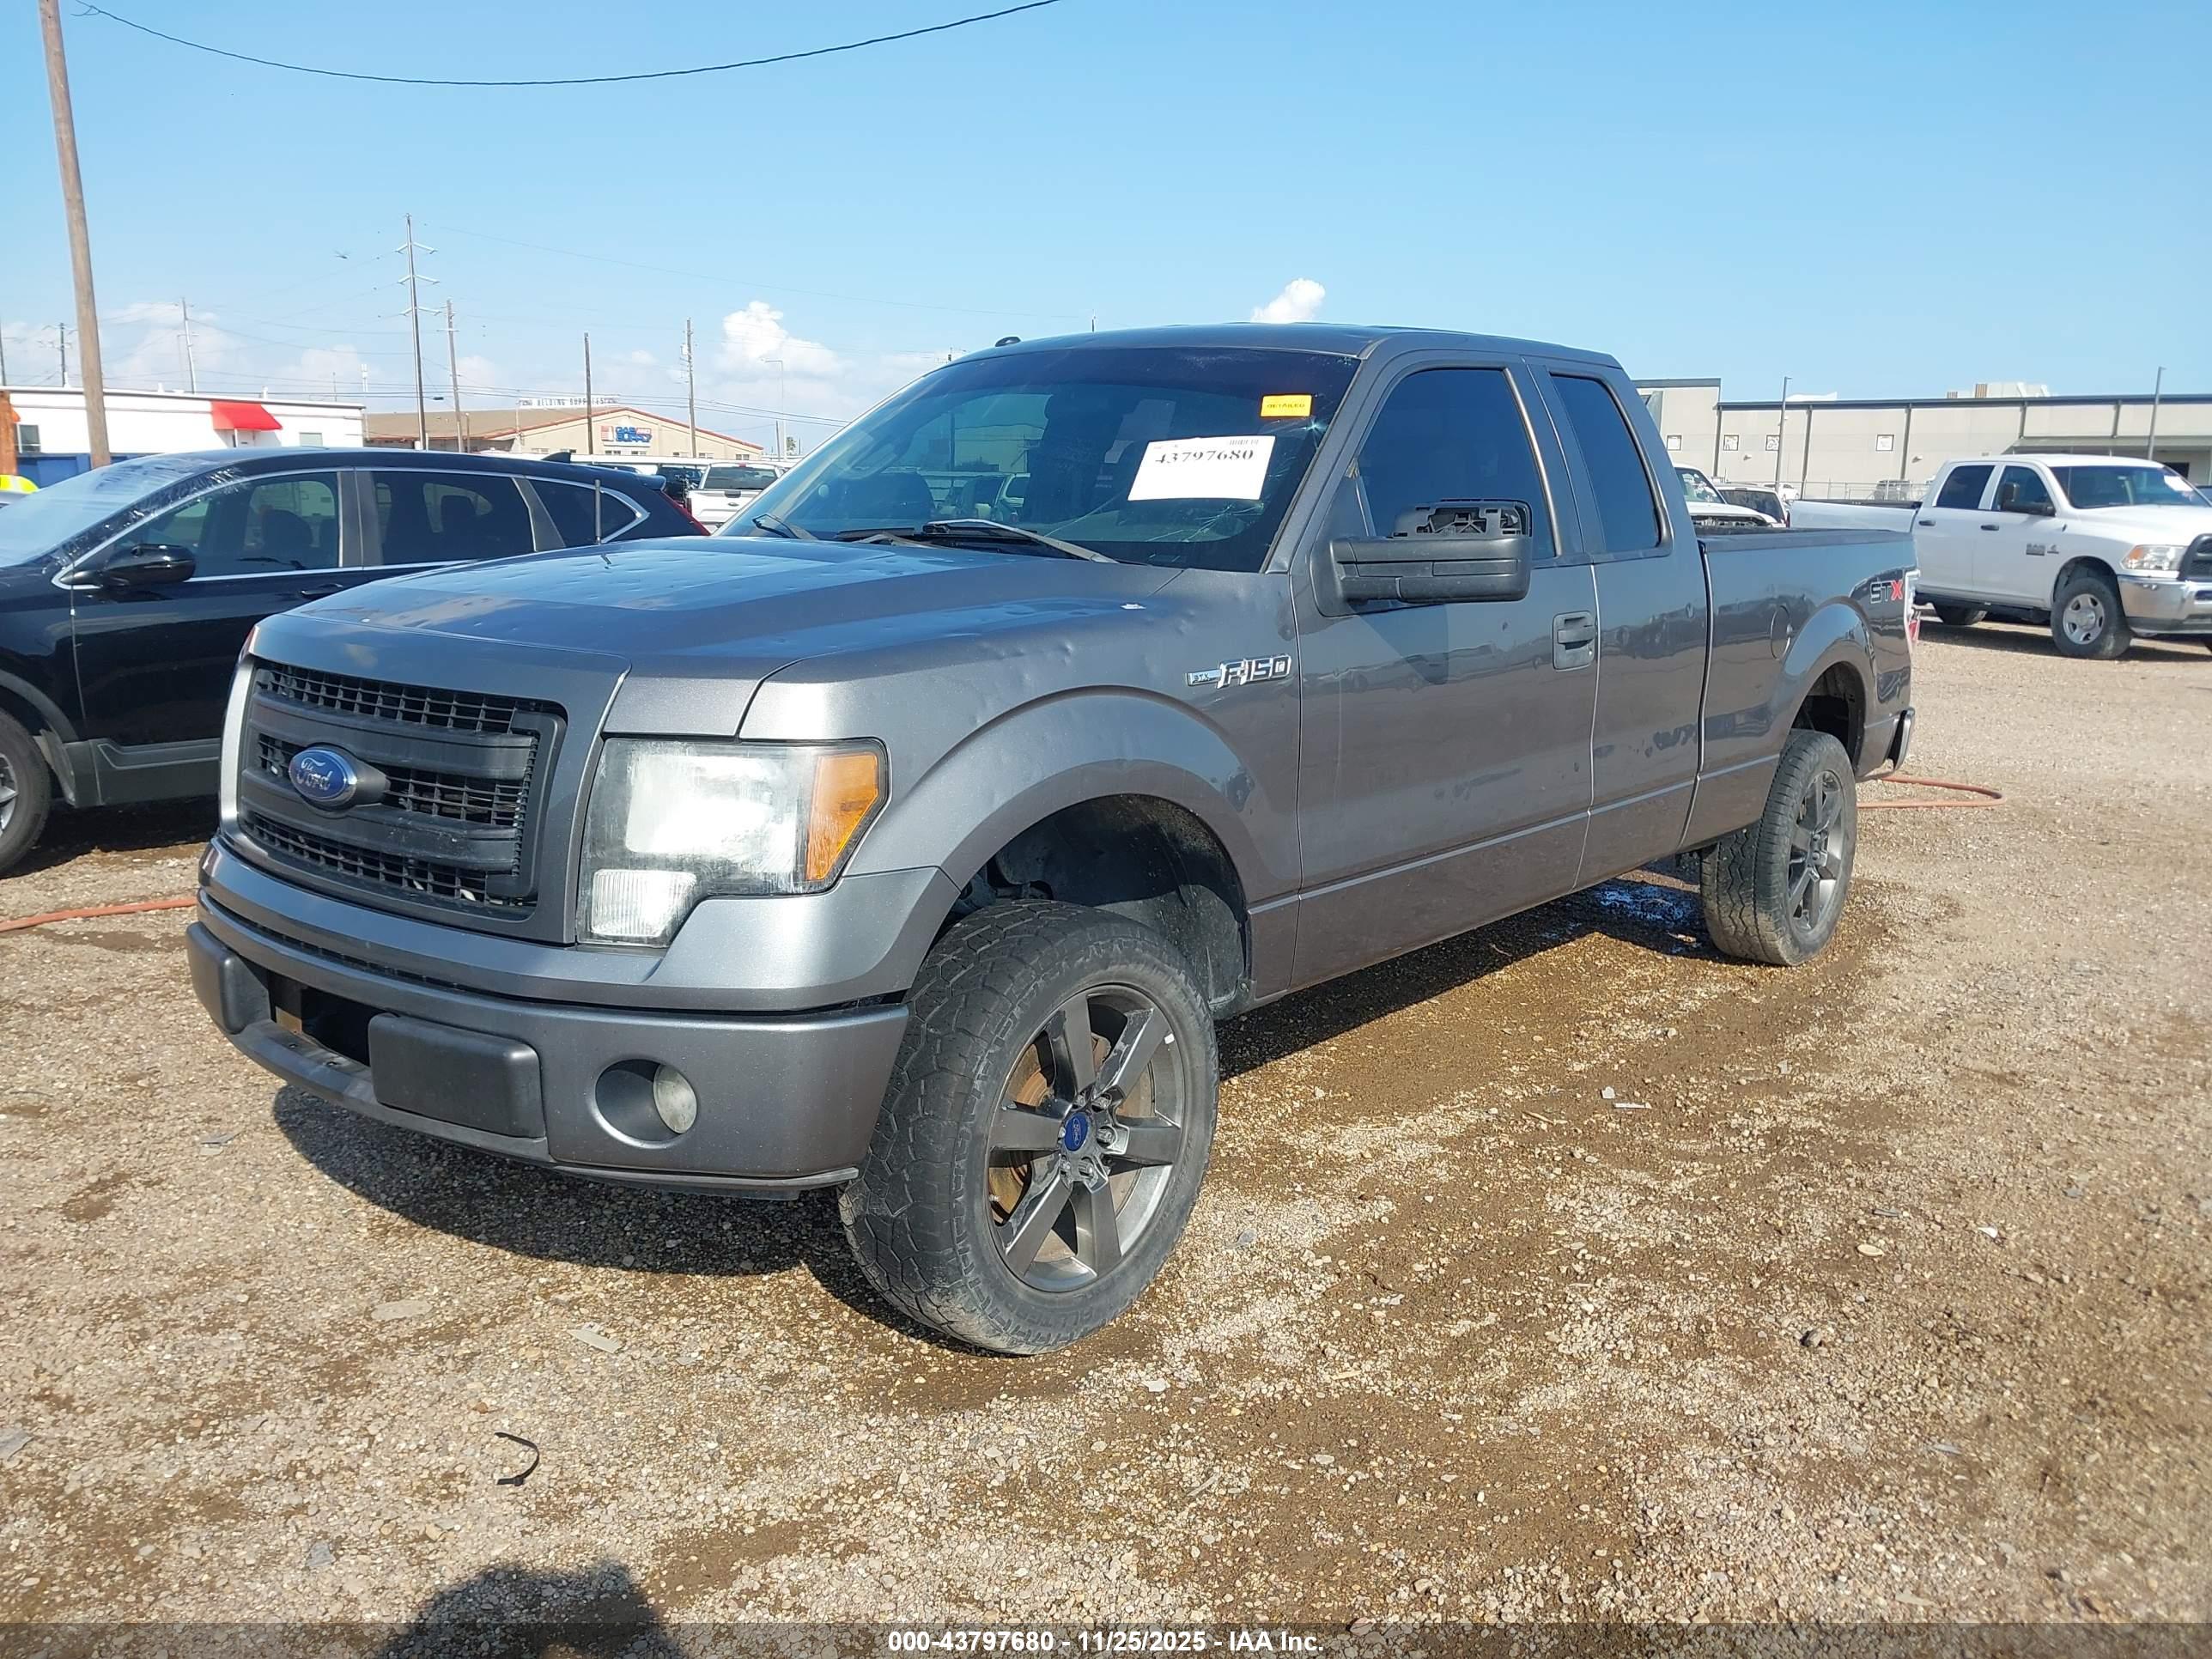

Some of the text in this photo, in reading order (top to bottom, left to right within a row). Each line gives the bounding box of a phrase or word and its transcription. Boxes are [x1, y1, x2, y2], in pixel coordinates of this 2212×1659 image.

[570, 397, 604, 405] SUPPIES
[1155, 449, 1254, 464] 43797680
[1870, 580, 1903, 604] STX
[296, 757, 333, 790] Ford
